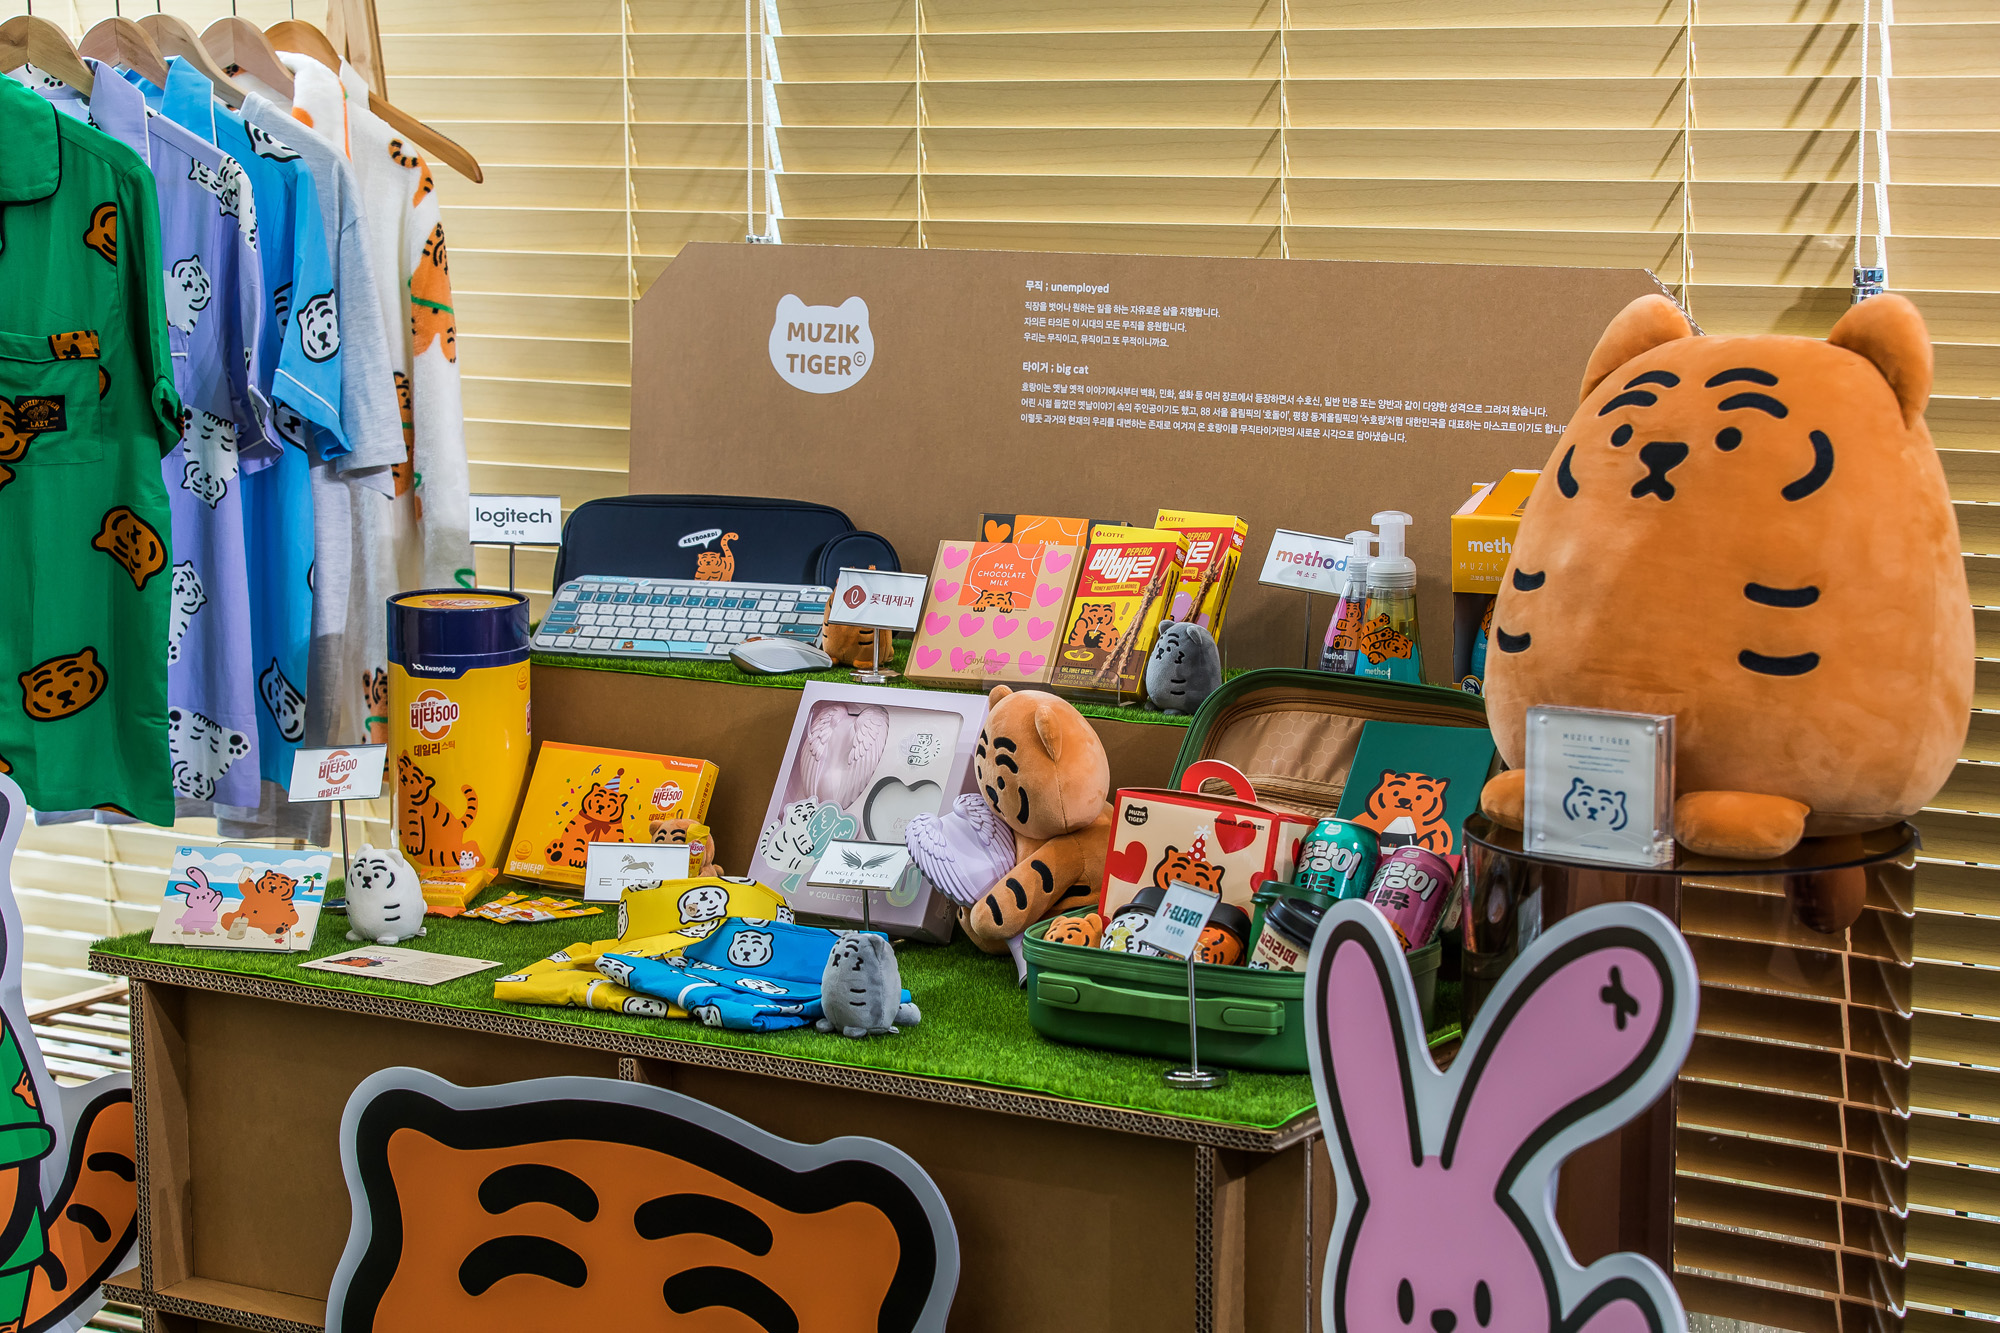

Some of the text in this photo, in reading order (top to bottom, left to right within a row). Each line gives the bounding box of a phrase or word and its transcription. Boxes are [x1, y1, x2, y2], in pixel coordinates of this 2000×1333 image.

[1025, 280, 1043, 291] 무직
[1051, 283, 1109, 294] unemployed
[1025, 302, 1220, 318] 직장을 벗어나 원하는 일을 하는 자유로운 삶을 지향합니다.
[1024, 317, 1187, 332] 자의든 타의든 이 시대의 모든 무직을 응원합니다.
[787, 321, 860, 345] MUZIK
[1024, 332, 1169, 347] 우리는 무직이고, 뮤직이고 또 무적이니까요.
[1023, 361, 1048, 373] 타이거
[1057, 363, 1071, 376] big
[1073, 365, 1089, 374] cat
[1021, 382, 1051, 393] 호랑이는
[1053, 384, 1068, 393] 옛날
[1069, 385, 1084, 394] 옛적
[1086, 386, 1138, 397] 이야기에서부터
[1141, 388, 1157, 399] 벽화,
[1160, 389, 1176, 400] 민화,
[1178, 390, 1194, 399] 설화
[1195, 391, 1203, 400] 등
[1205, 391, 1220, 401] 여러
[1222, 392, 1253, 402] 장르에서
[1255, 393, 1294, 404] 등장하면서
[1296, 395, 1322, 407] 수호신,
[1324, 397, 1340, 407] 일반
[1360, 399, 1376, 408] 또는
[1378, 399, 1403, 410] 양반과
[1405, 401, 1420, 411] 같이
[1423, 401, 1448, 412] 다양한
[1449, 403, 1482, 413] 성격으로
[1484, 405, 1510, 415] 그려져
[1511, 406, 1548, 417] 왔습니다.
[1021, 398, 1035, 407] 어린
[1037, 399, 1052, 408] 시절
[1054, 399, 1076, 409] 들었던
[1078, 401, 1115, 411] 옛날이야기
[1117, 403, 1132, 412] 속의
[1134, 403, 1179, 414] 주인공이기도
[1201, 407, 1210, 416] 88
[1213, 408, 1228, 417] 서울
[1230, 408, 1261, 419] 올림픽의
[1293, 411, 1309, 421] 평창
[1311, 412, 1358, 424] 동계올림픽의
[1405, 417, 1446, 428] 대한민국을
[1449, 419, 1482, 430] 대표하는
[1484, 421, 1542, 433] 마스코트이기도
[30, 420, 49, 428] LAZY
[1021, 413, 1407, 443] 이렇듯 과거와 현재의 우리를 대변하는 존재로 여겨져 온 호랑이를 무직타이거만의 새로운 시각으로 담아냈습니다.
[476, 507, 552, 528] logitech
[683, 531, 718, 545] KEYBOARD!
[1468, 536, 1512, 554] meth
[1125, 546, 1153, 557] PEPERO
[994, 562, 1015, 570] PAVE
[1088, 547, 1157, 584] 빼빼로
[1276, 549, 1349, 573] method
[1459, 561, 1499, 572] MUZIK
[977, 570, 1027, 579] CHOCOLATE
[1296, 570, 1318, 580] 메소드
[989, 579, 1010, 587] MILK
[870, 593, 914, 608] 롯데제과
[1323, 652, 1348, 661] method
[424, 665, 456, 674] Kwangdong
[411, 703, 459, 730] 비타500
[1562, 733, 1631, 746] MUZIK TIGER
[413, 740, 456, 757] 데일리 스틱
[318, 758, 358, 779] 비타500
[317, 783, 352, 798] 데일리 스틱
[651, 789, 683, 805] 비타500
[648, 813, 667, 821] 데일리
[1128, 809, 1146, 818] MUZIK
[510, 860, 545, 875] 멀티비타민
